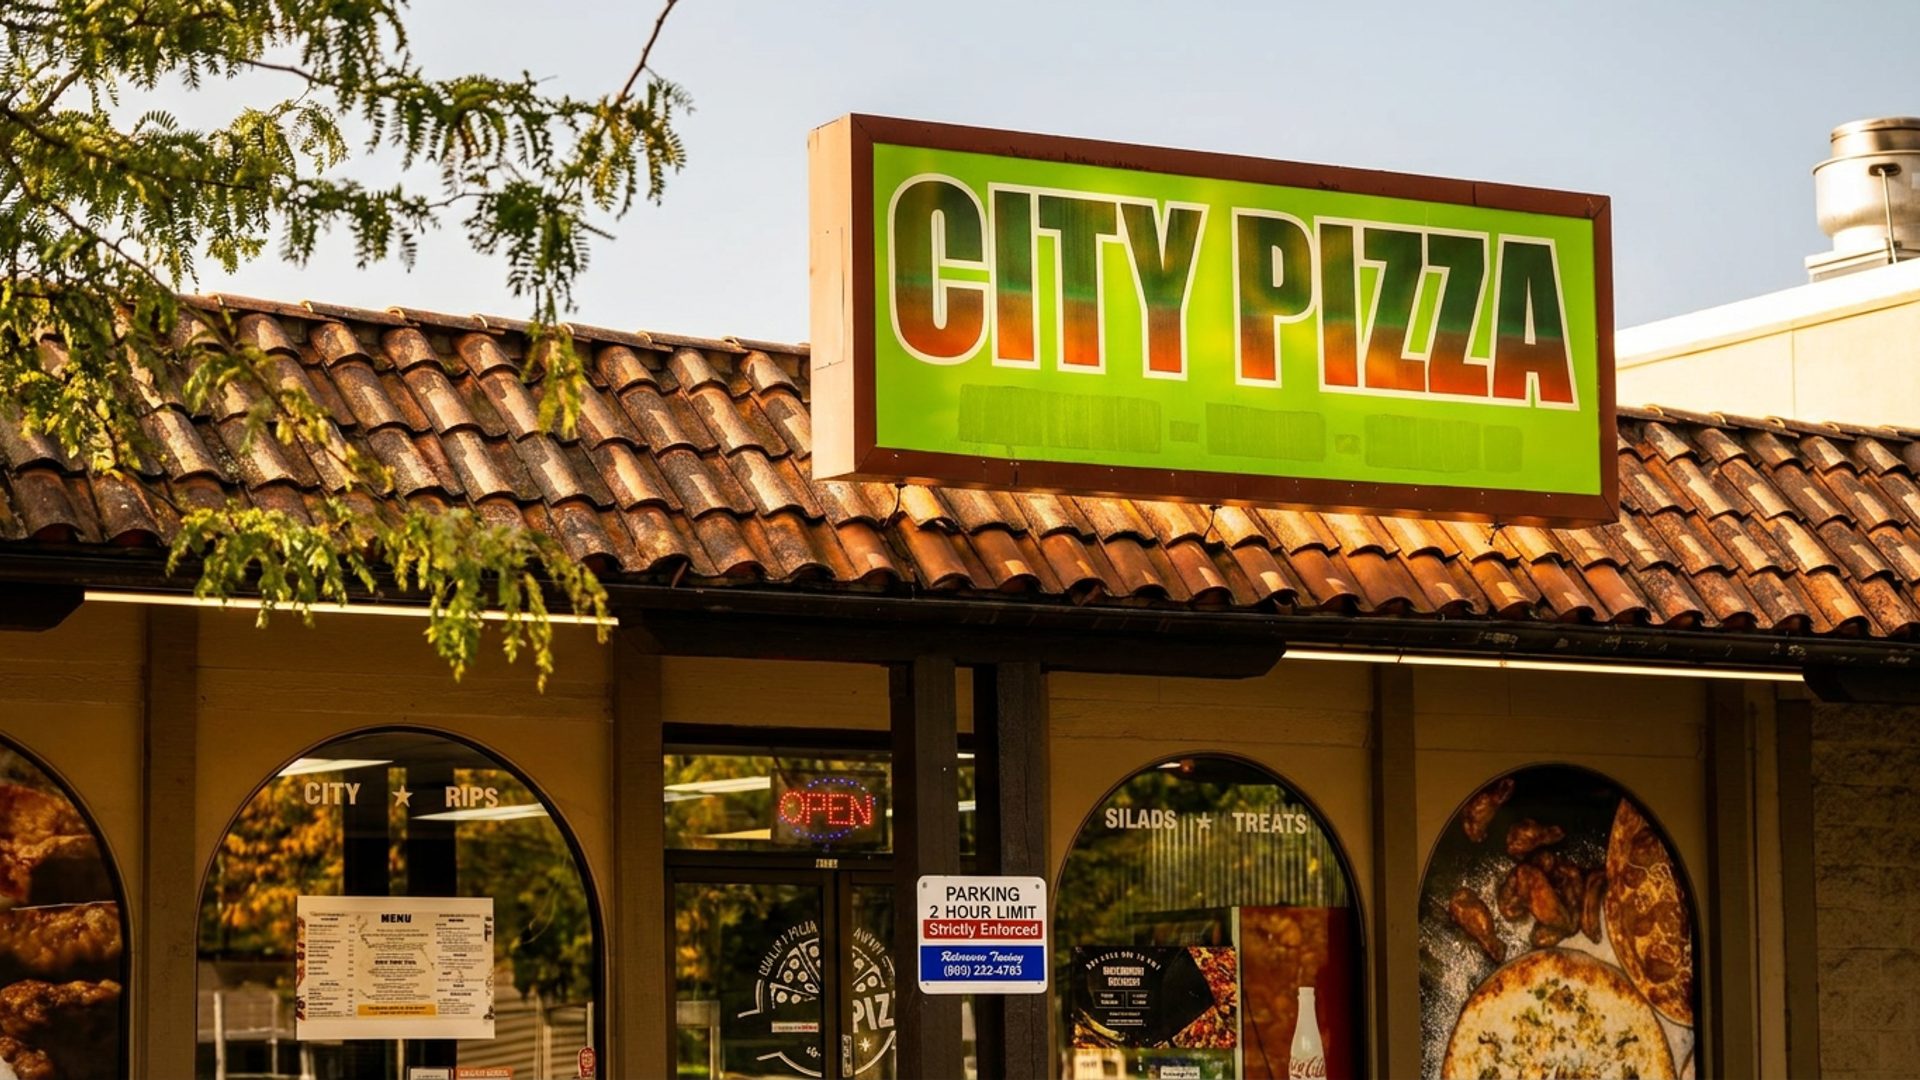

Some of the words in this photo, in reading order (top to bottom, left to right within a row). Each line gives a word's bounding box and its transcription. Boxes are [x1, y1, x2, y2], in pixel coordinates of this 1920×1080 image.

[888, 173, 1210, 380] CITY
[1232, 207, 1580, 411] PIZZA
[304, 782, 361, 805] CITY
[445, 786, 499, 808] RIPS
[780, 791, 872, 825] OPEN
[1105, 808, 1177, 829] SILADS
[1232, 812, 1307, 834] TREATS
[946, 886, 1020, 902] PARKING
[381, 914, 412, 923] MENU
[929, 905, 939, 919] 2
[946, 905, 992, 919] HOUR
[997, 905, 1037, 919] LIMIT
[929, 922, 977, 938] Strictly
[980, 923, 1039, 936] Enforced
[853, 993, 896, 1034] PIZ
